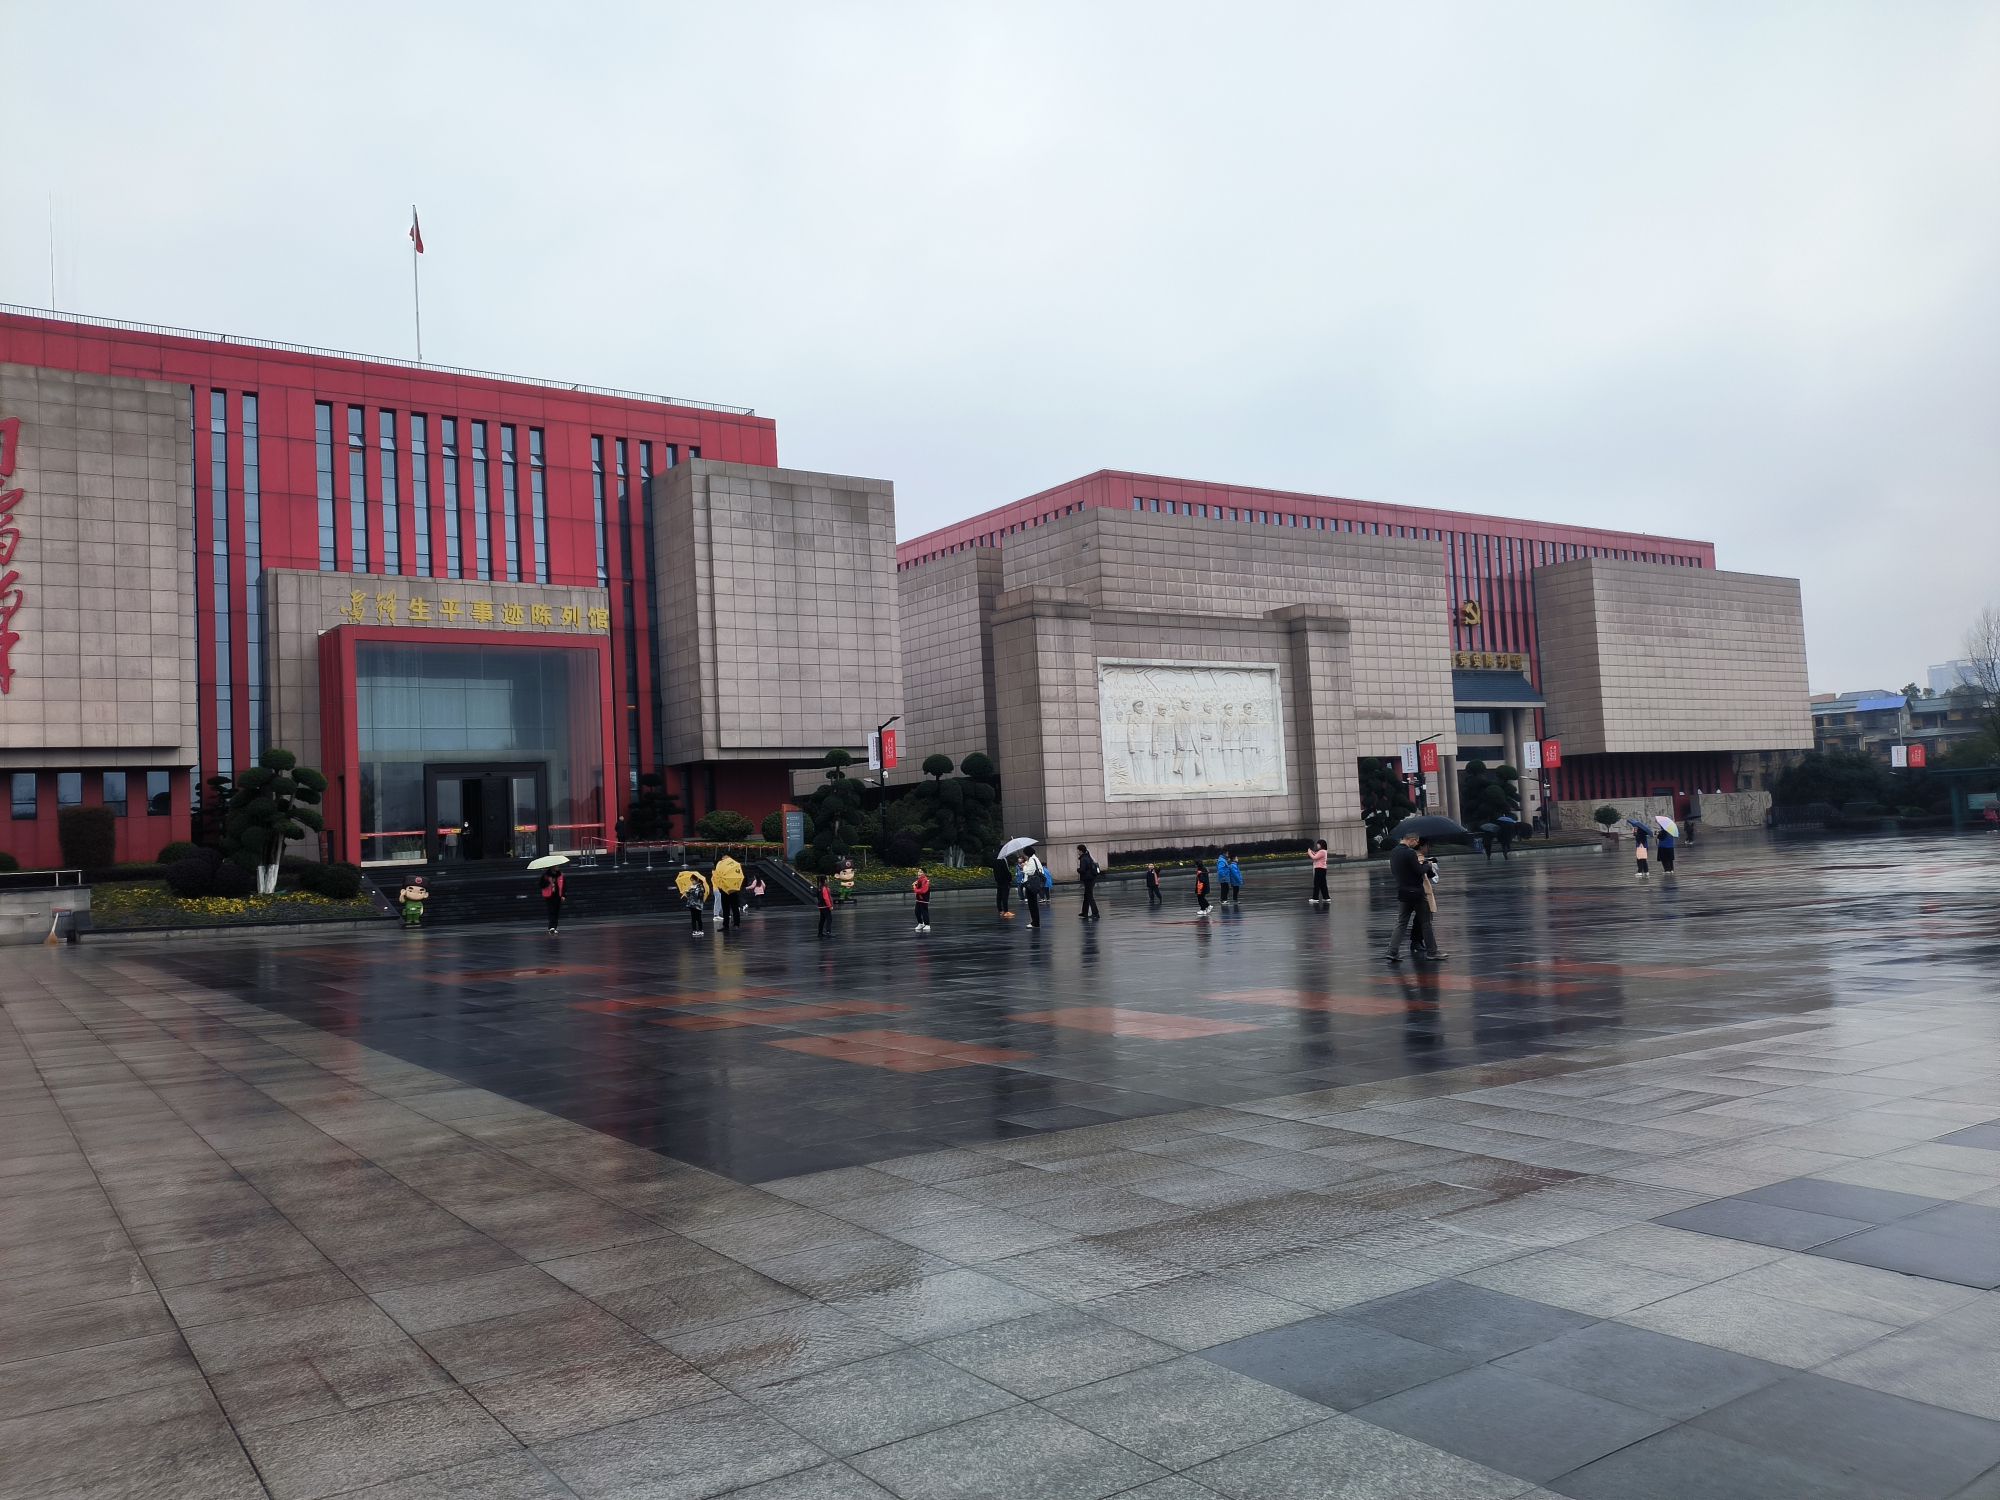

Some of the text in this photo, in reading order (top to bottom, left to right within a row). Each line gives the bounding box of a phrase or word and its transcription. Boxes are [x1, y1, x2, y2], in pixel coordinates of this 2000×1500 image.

[1451, 650, 1523, 669] 党史陈列馆
